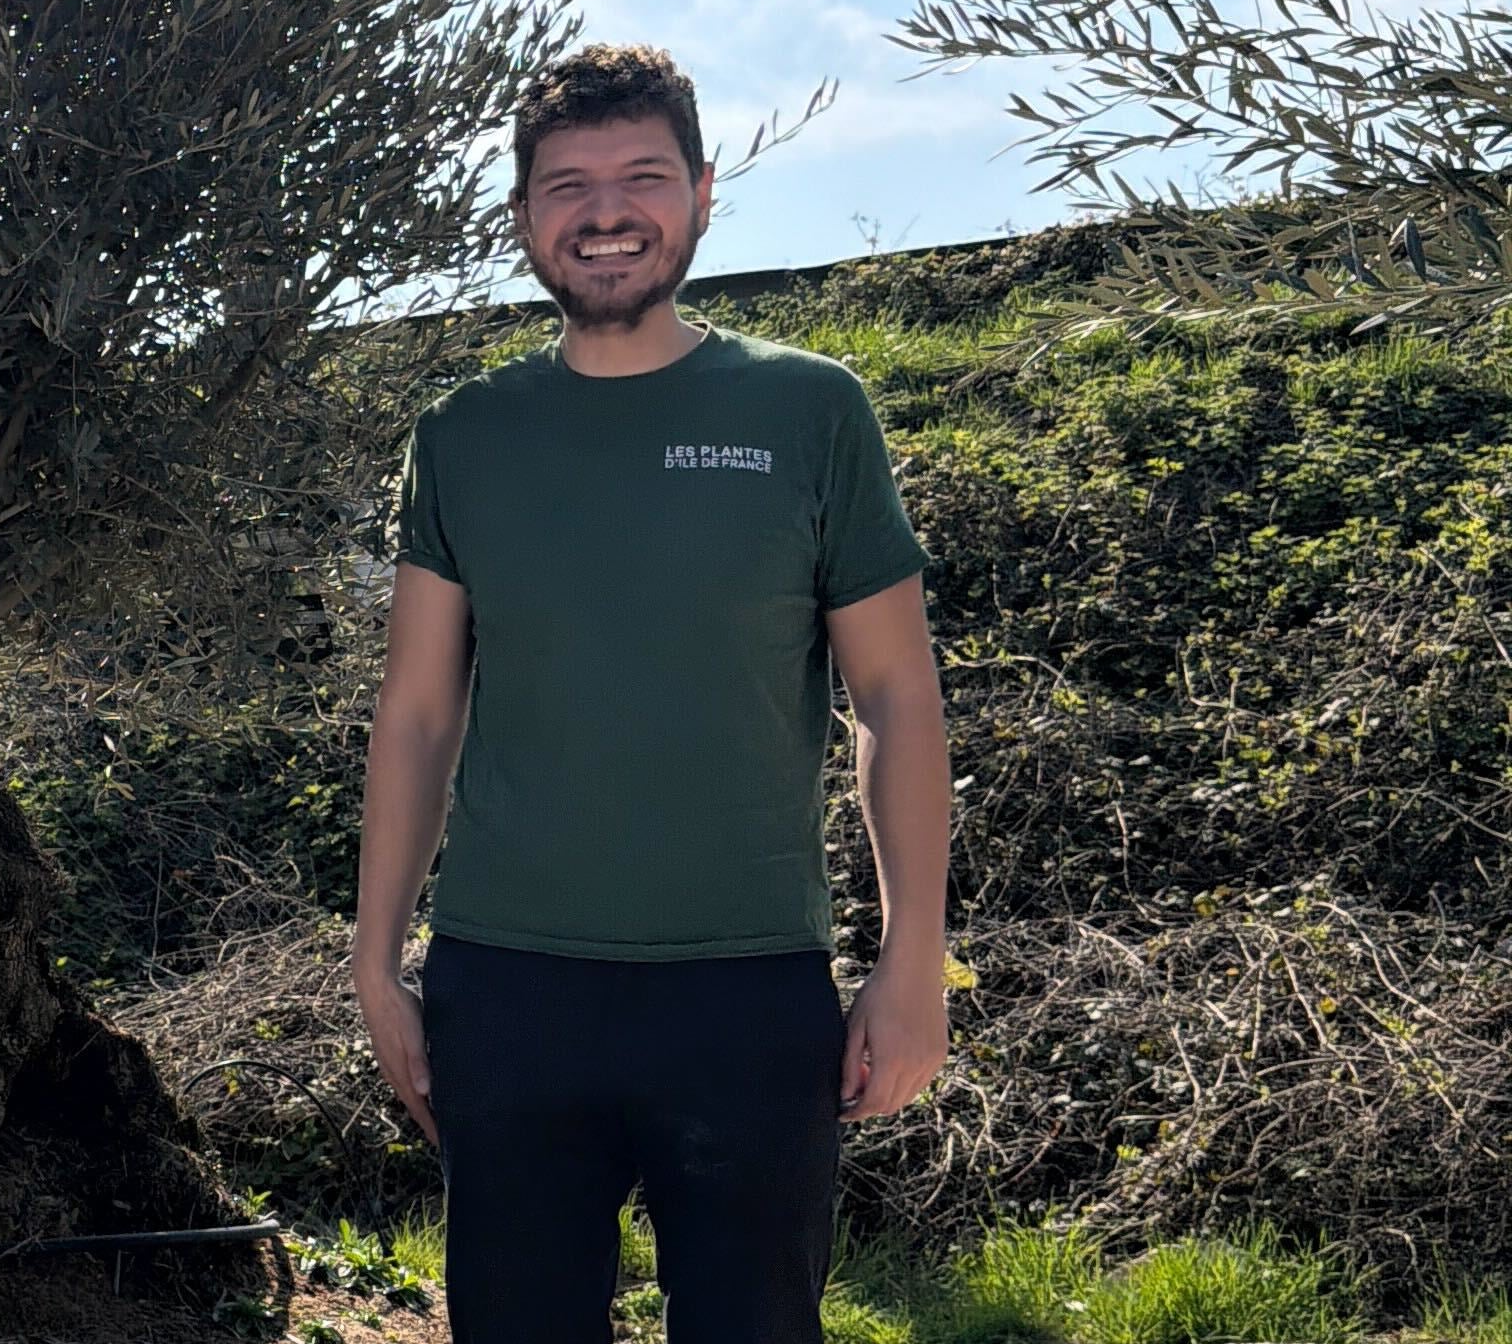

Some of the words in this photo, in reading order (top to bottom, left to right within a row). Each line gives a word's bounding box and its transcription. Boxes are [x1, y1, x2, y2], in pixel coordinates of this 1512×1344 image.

[665, 445, 695, 458] LES
[701, 445, 772, 463] PLANTES
[701, 457, 720, 468] DE
[722, 458, 772, 474] FRANCE
